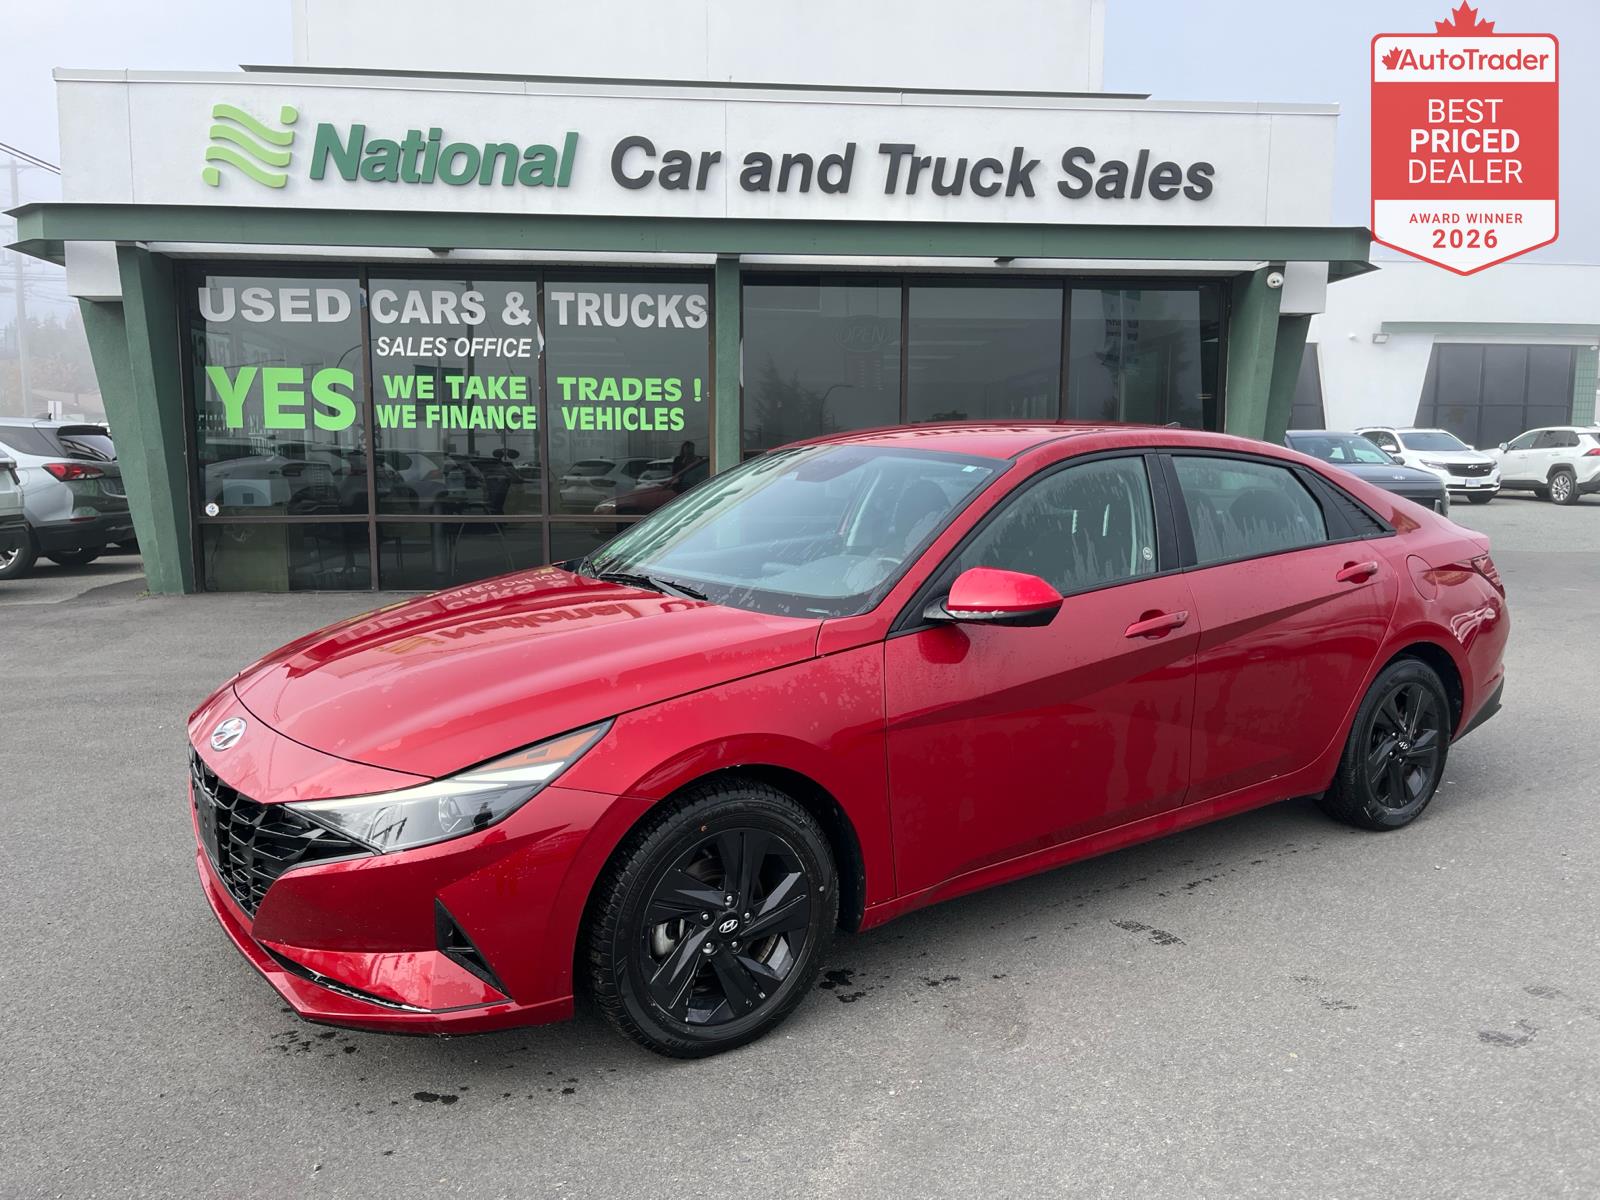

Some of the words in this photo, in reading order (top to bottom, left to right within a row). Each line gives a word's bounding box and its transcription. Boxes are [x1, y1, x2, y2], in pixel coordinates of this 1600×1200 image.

[309, 123, 579, 188] National
[611, 136, 722, 191] Car
[740, 142, 857, 194] and
[878, 143, 1041, 198] Truck
[1057, 146, 1216, 201] Sales
[198, 287, 351, 323] USED
[371, 289, 486, 326] CARS
[502, 291, 532, 326] &
[551, 291, 708, 329] TRUCKS
[376, 336, 447, 358] SALES
[454, 337, 532, 358] OFFICE
[205, 366, 357, 431] YES
[382, 375, 434, 399] WE
[445, 375, 527, 400] TAKE
[557, 376, 683, 402] TRADES
[376, 404, 417, 429] WE
[426, 405, 538, 430] FINANCE
[561, 406, 685, 431] VEHICLES
